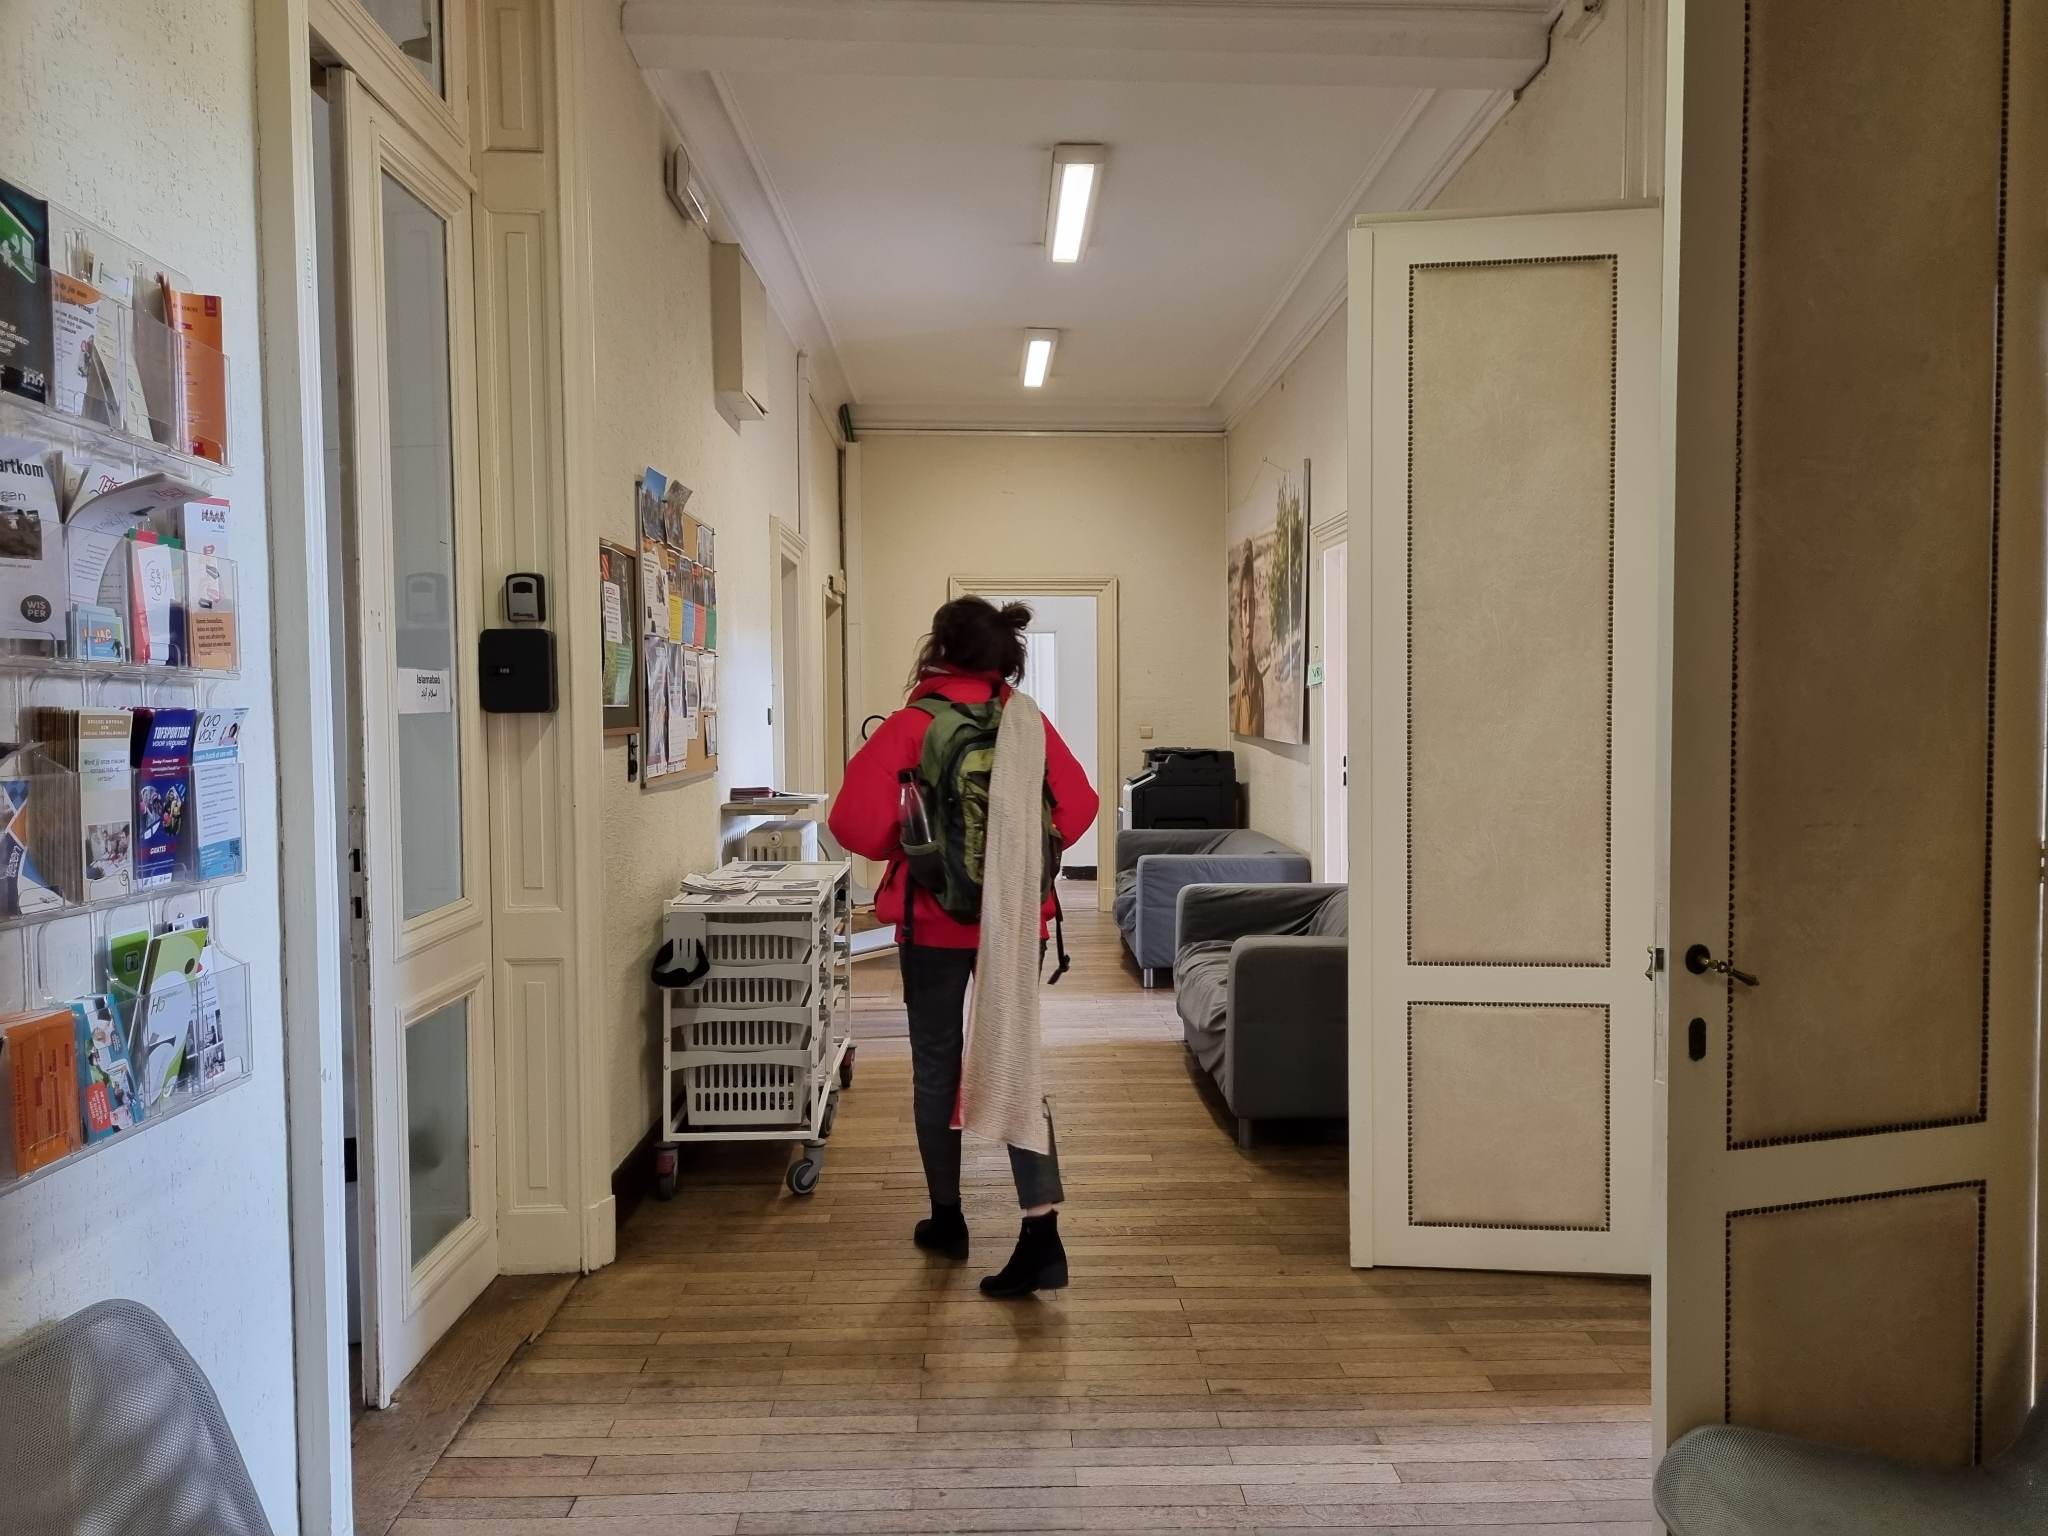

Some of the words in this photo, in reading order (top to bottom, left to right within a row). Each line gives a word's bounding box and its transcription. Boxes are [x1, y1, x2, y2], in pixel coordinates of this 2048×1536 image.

[26, 601, 46, 610] WIS
[27, 609, 47, 618] PER
[416, 674, 440, 684] Islamabad
